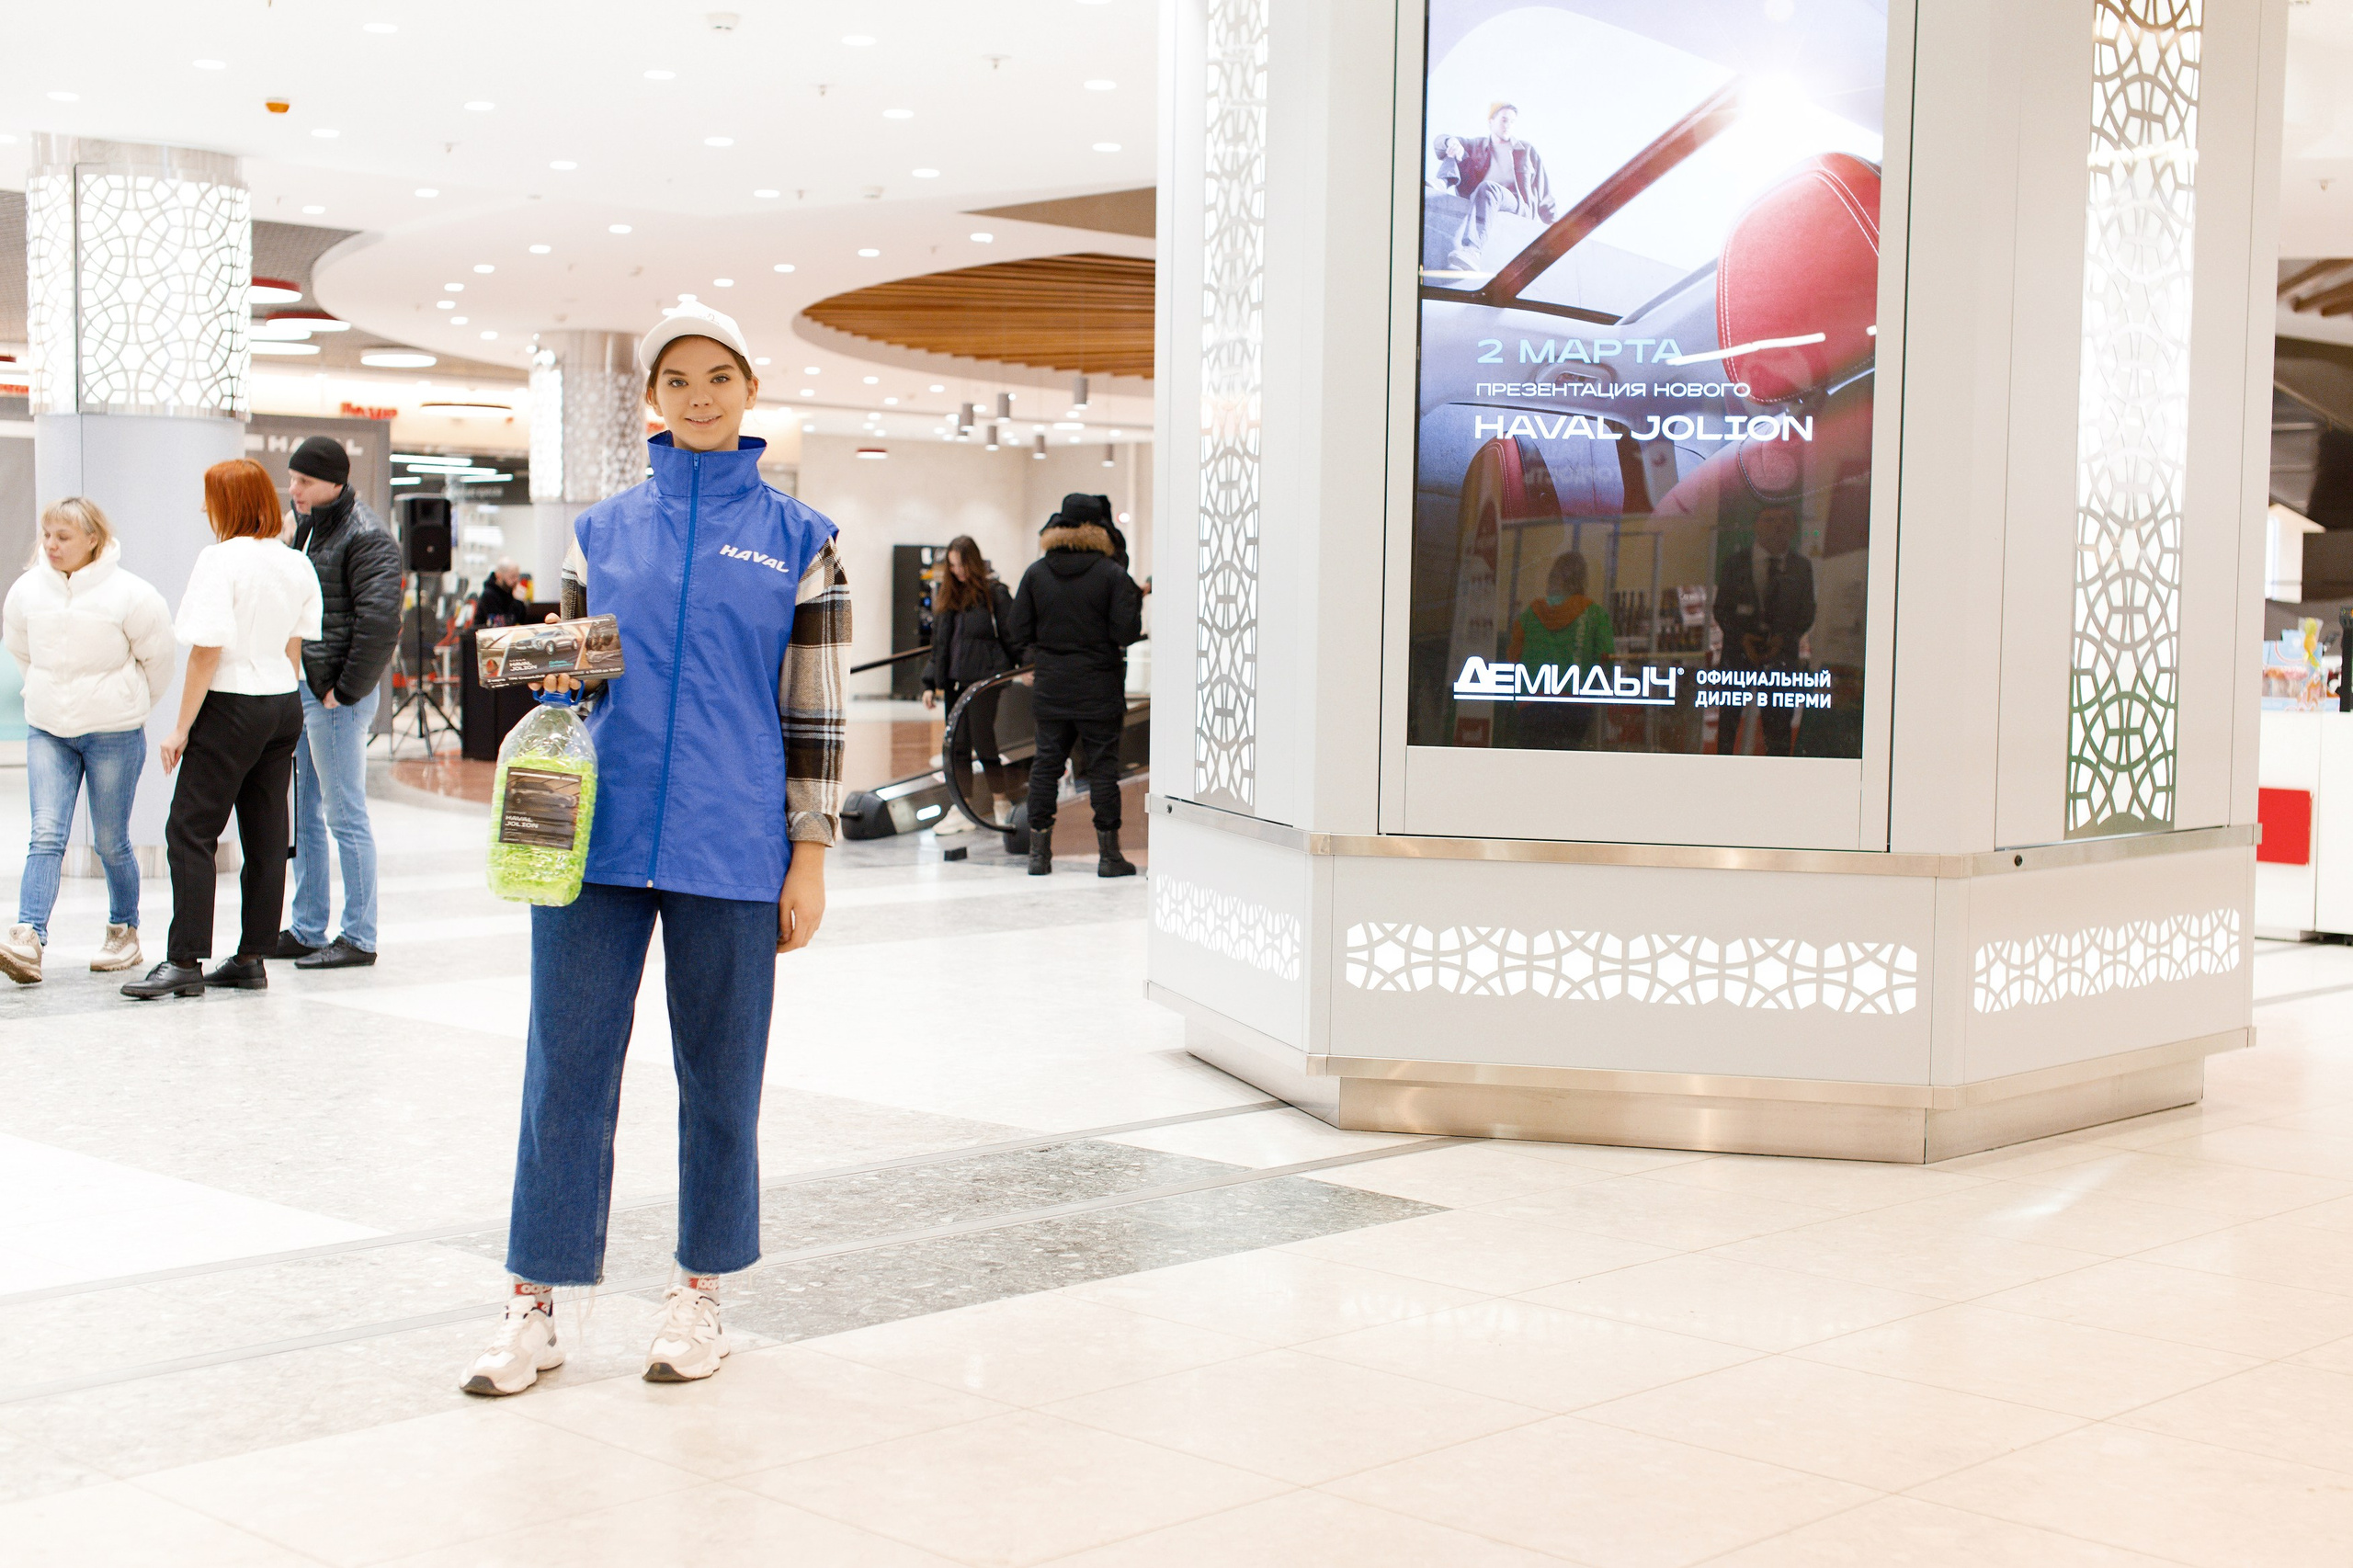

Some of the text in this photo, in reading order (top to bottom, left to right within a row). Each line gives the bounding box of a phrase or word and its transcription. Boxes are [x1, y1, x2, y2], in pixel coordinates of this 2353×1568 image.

[1477, 338, 1685, 365] 2 МАРТА
[1475, 382, 1751, 399] ПРЕЗЕНТАЦИЯ НОВОГО
[1474, 415, 1813, 441] HAVAL JOLION
[719, 544, 790, 574] HAVAL
[1453, 655, 1677, 699] ДЕМИДЫЧ
[1696, 669, 1832, 688] ОФИЦИАЛЬНЫЙ
[1695, 690, 1832, 709] ДИЛЕР В ПЕРМИ
[505, 821, 540, 829] JOLION
